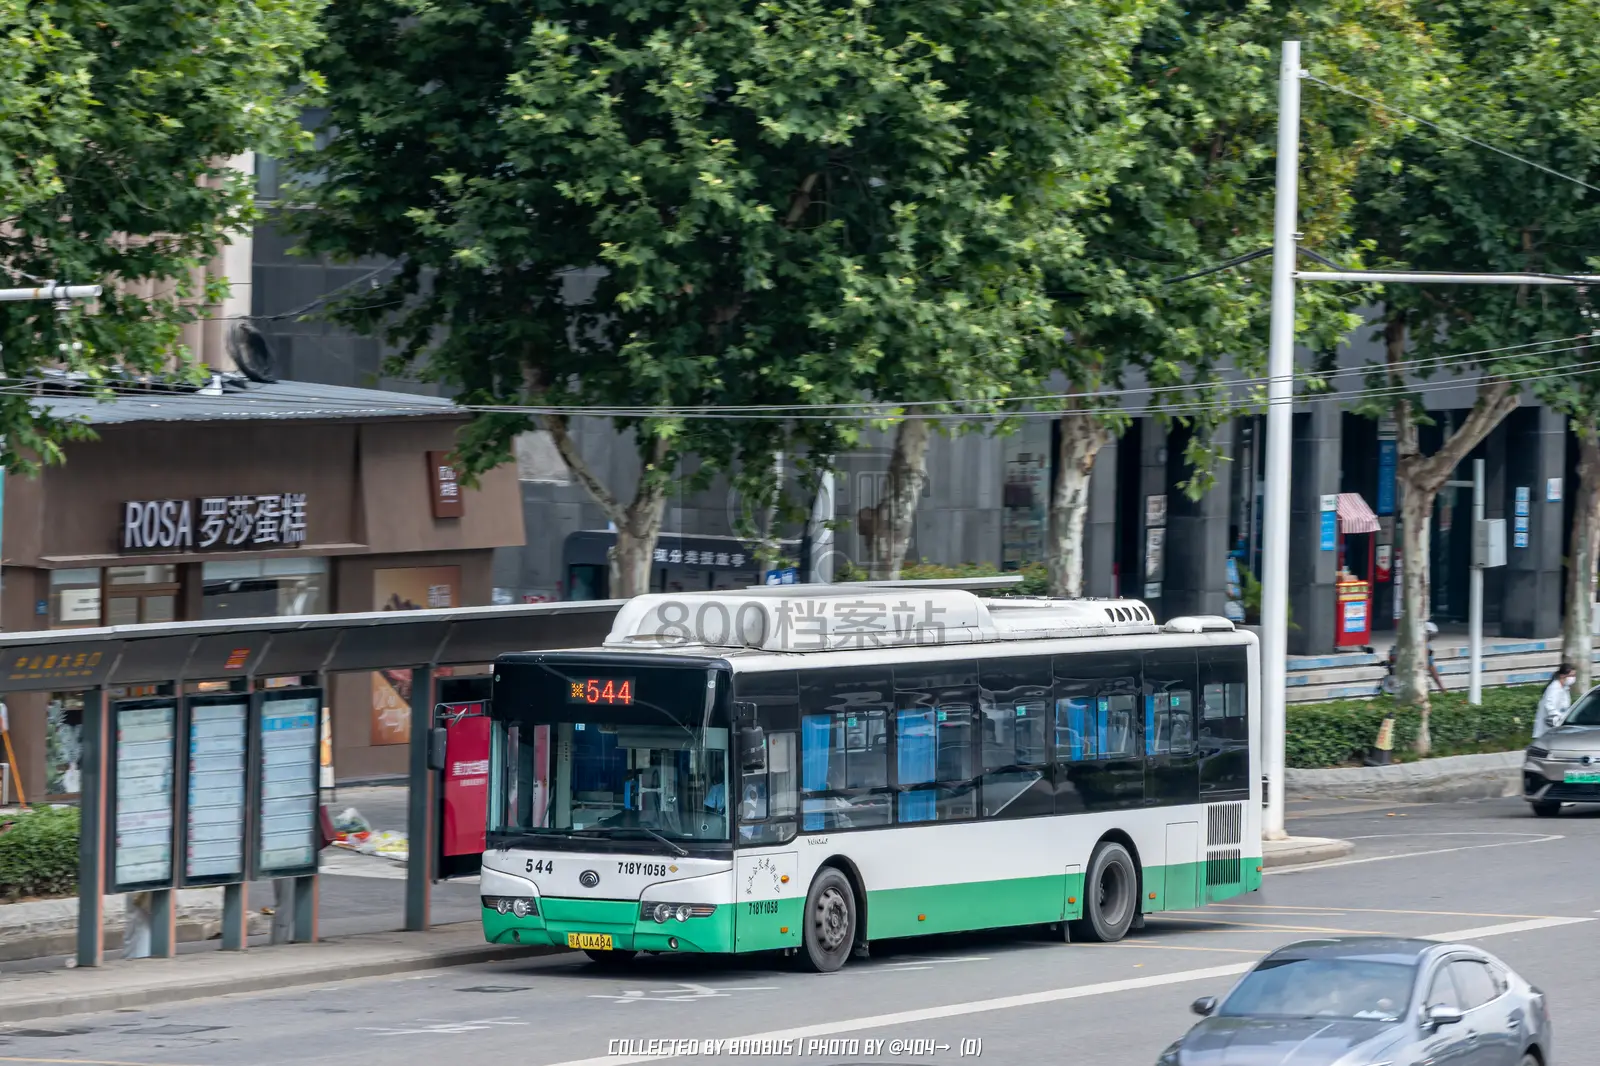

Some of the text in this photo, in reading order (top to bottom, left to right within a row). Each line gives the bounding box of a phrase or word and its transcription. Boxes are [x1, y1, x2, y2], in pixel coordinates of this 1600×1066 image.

[124, 493, 307, 548] ROSA 罗莎蛋糕
[586, 679, 632, 704] 544
[525, 858, 553, 874] 544
[617, 861, 666, 877] 718Y1058
[748, 900, 779, 915] 718Y1058
